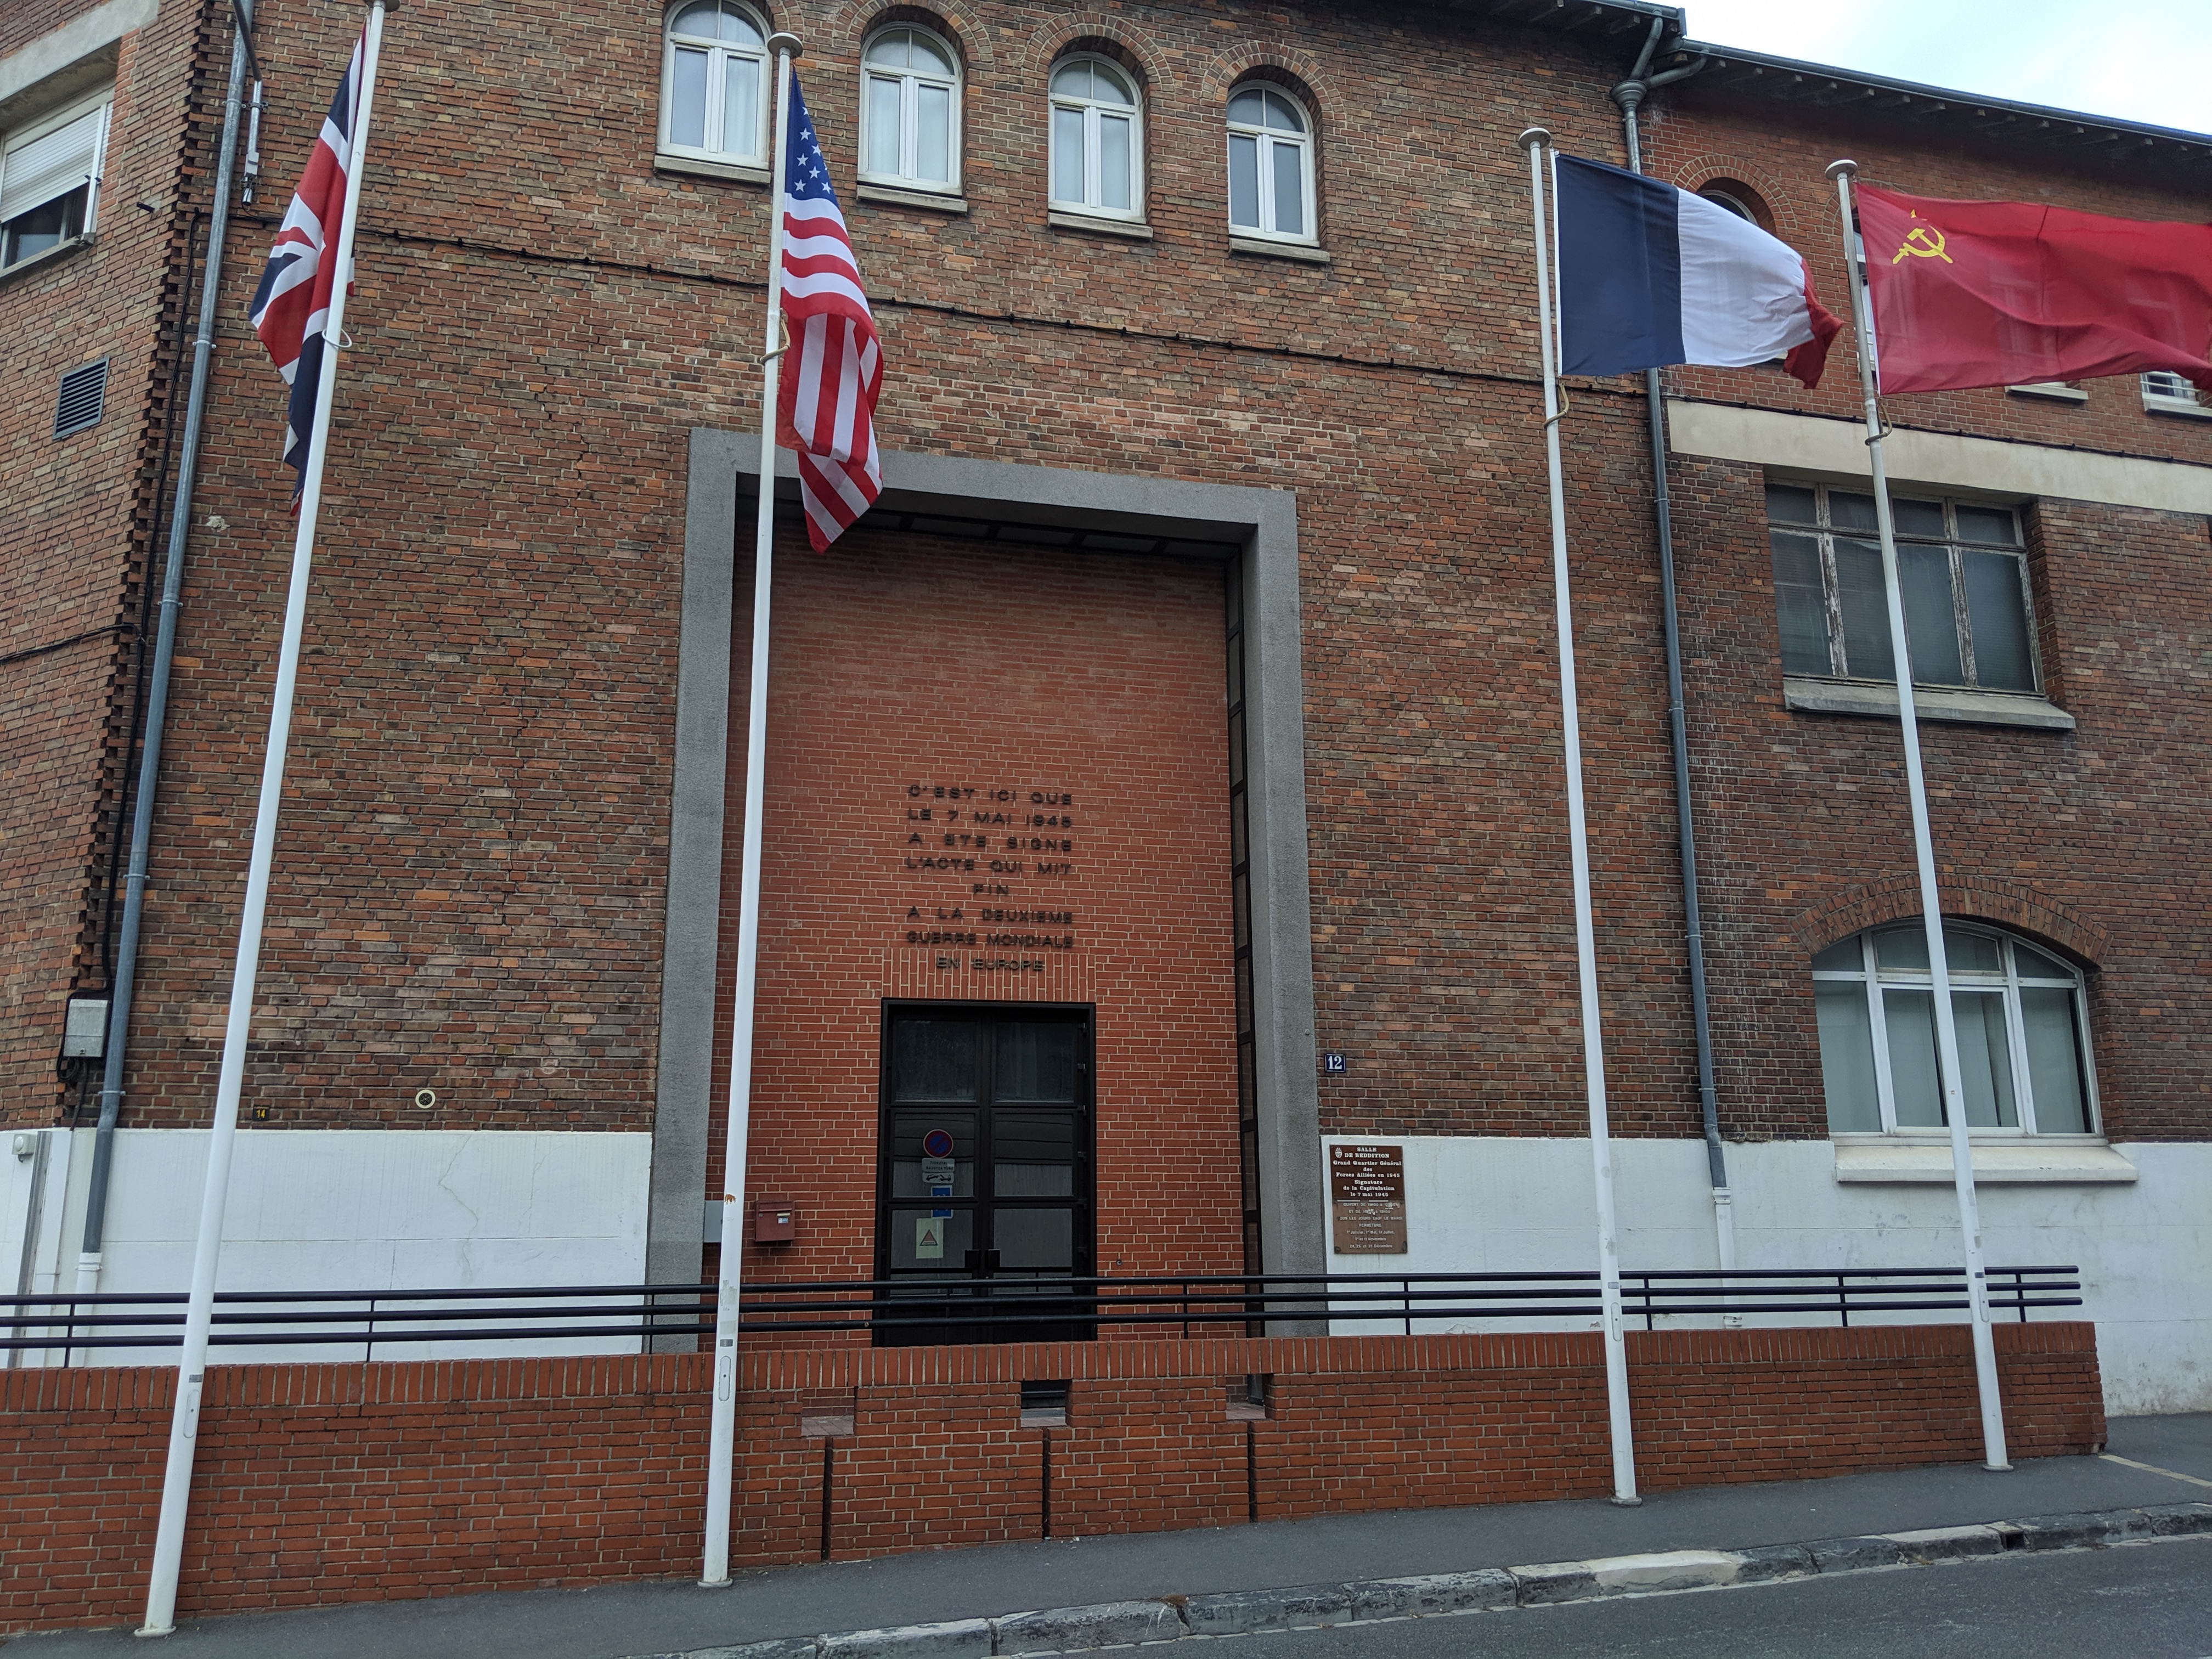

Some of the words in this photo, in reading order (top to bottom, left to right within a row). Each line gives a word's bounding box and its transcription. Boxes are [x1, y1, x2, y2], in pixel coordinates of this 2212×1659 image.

[909, 784, 975, 799] C'EST
[990, 789, 1016, 801] ICI
[1031, 792, 1072, 805] QUE
[908, 808, 932, 820] LE
[948, 810, 958, 821] 7
[975, 811, 1011, 823] MAI
[1026, 814, 1072, 827] 1945
[909, 832, 922, 843] A
[944, 833, 986, 847] ETE
[1007, 837, 1072, 851] SIGNE
[907, 856, 975, 870] L'ACTE
[989, 860, 1022, 872] QUI
[1037, 862, 1071, 874] MIT
[973, 884, 1008, 895] FIN
[907, 905, 920, 917] A
[938, 907, 963, 918] LA
[982, 909, 1073, 923] DEUXIEME
[906, 930, 977, 944] GUERRE
[988, 934, 1073, 947] MONDIALE
[936, 956, 960, 968] EN
[973, 958, 1043, 971] EUROPE
[1328, 1056, 1342, 1069] 12
[257, 1109, 266, 1118] 14
